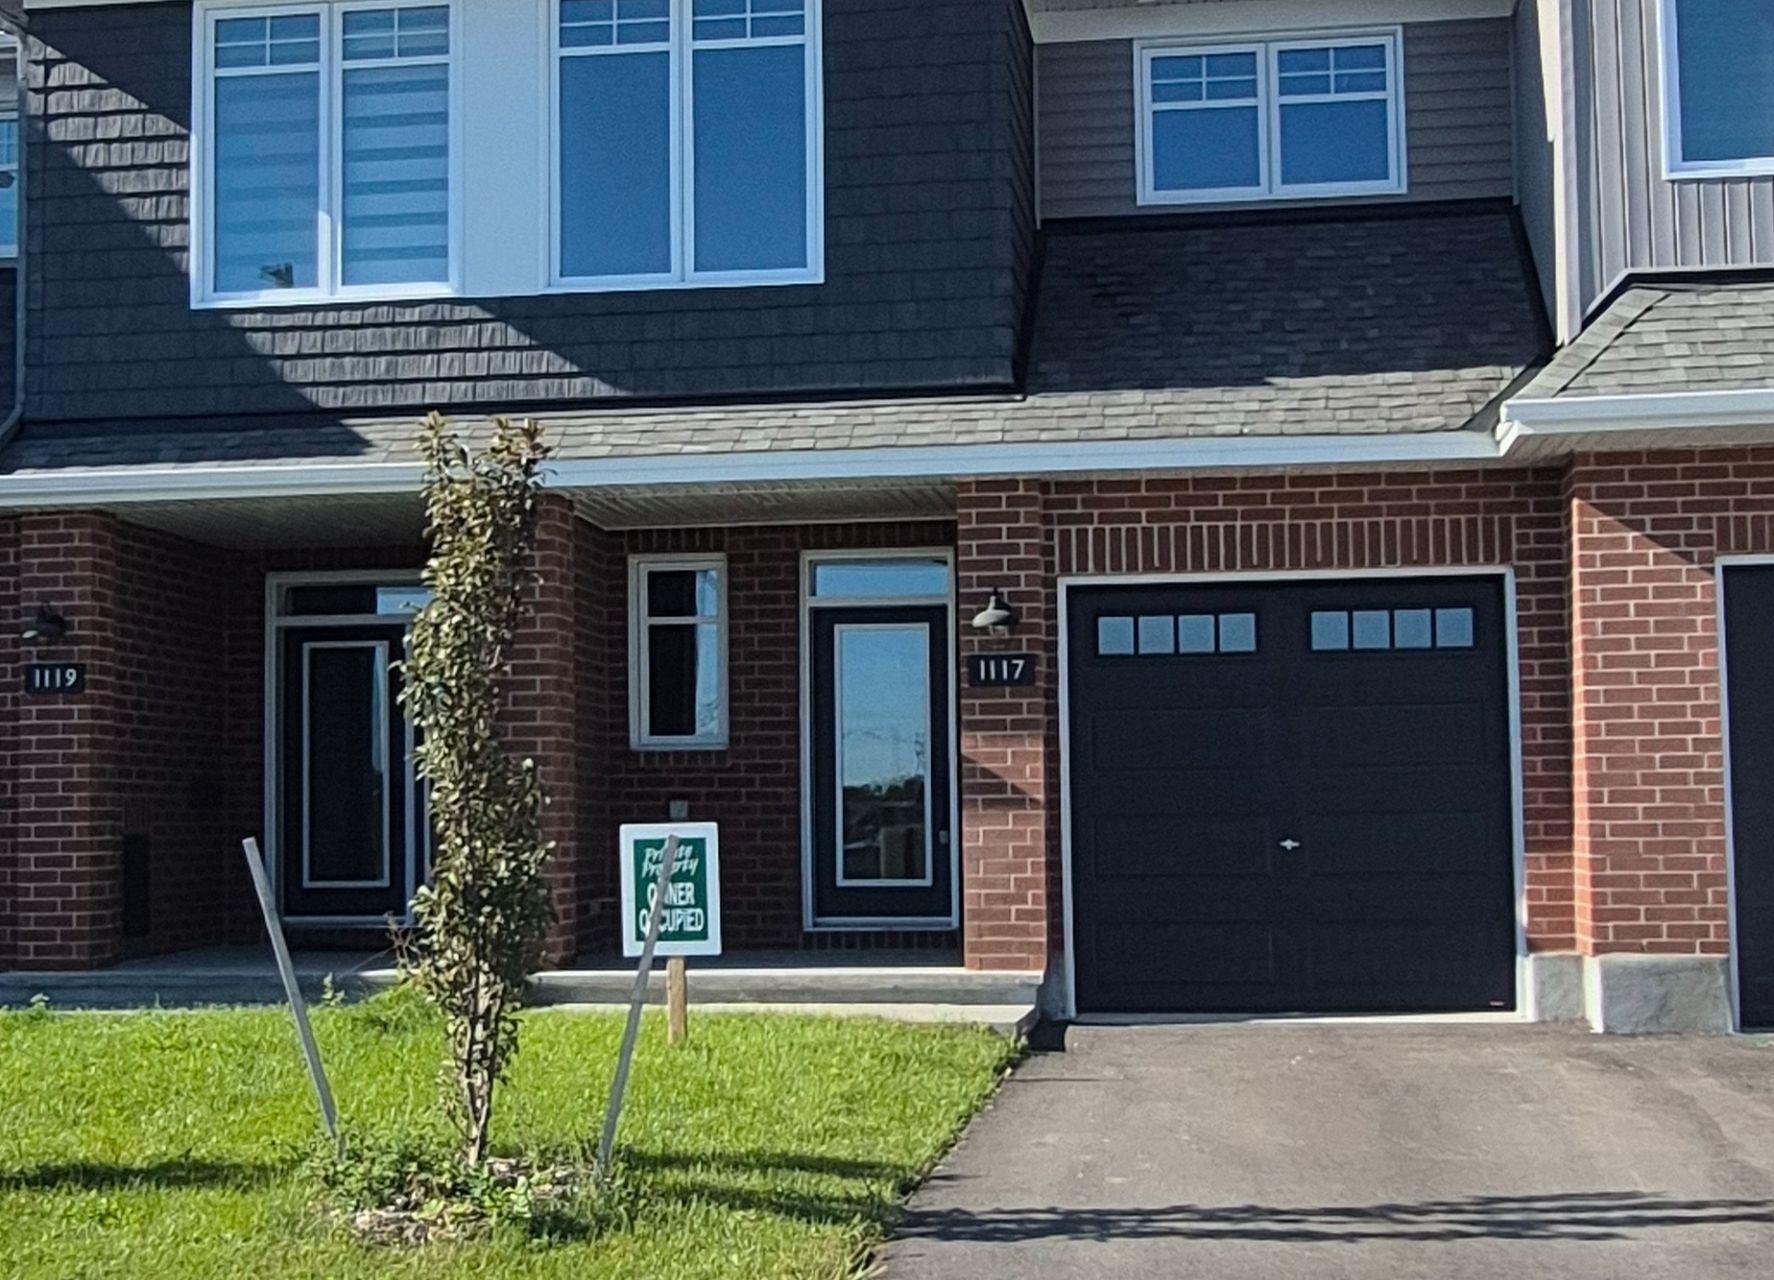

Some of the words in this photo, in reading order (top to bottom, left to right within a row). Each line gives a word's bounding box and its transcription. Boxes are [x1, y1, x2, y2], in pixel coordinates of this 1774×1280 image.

[34, 668, 77, 689] 1119
[980, 659, 1025, 680] 1117
[647, 882, 695, 906] ONER
[639, 908, 704, 933] OCUPIED
